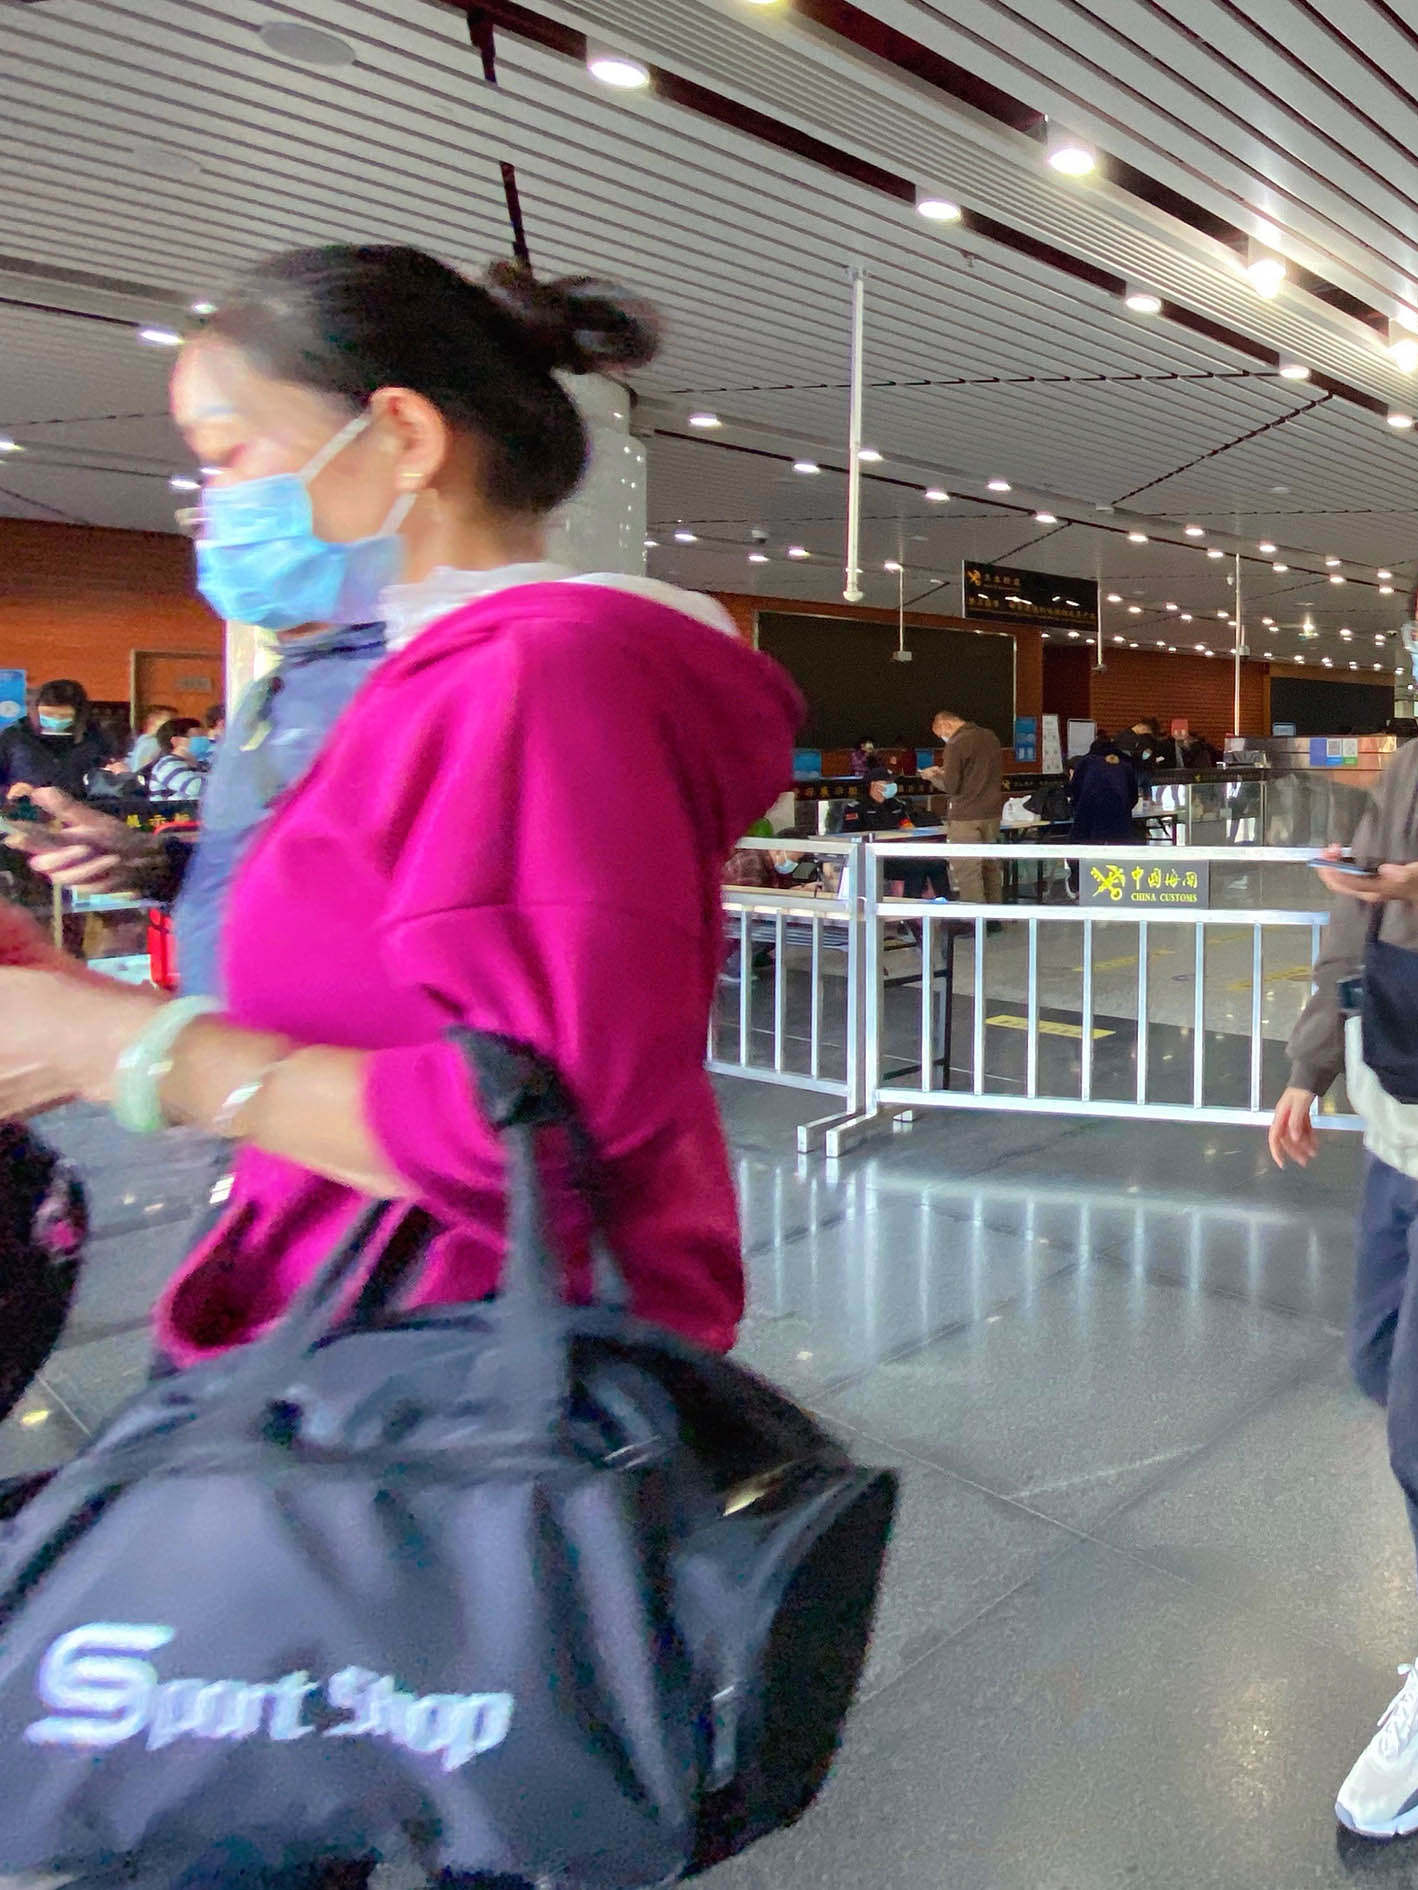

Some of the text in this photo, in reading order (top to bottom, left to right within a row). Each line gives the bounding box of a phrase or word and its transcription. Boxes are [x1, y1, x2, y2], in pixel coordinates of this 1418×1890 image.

[1130, 892, 1198, 903] CHINA CUSTOMS
[24, 1622, 514, 1772] Sport Shop
